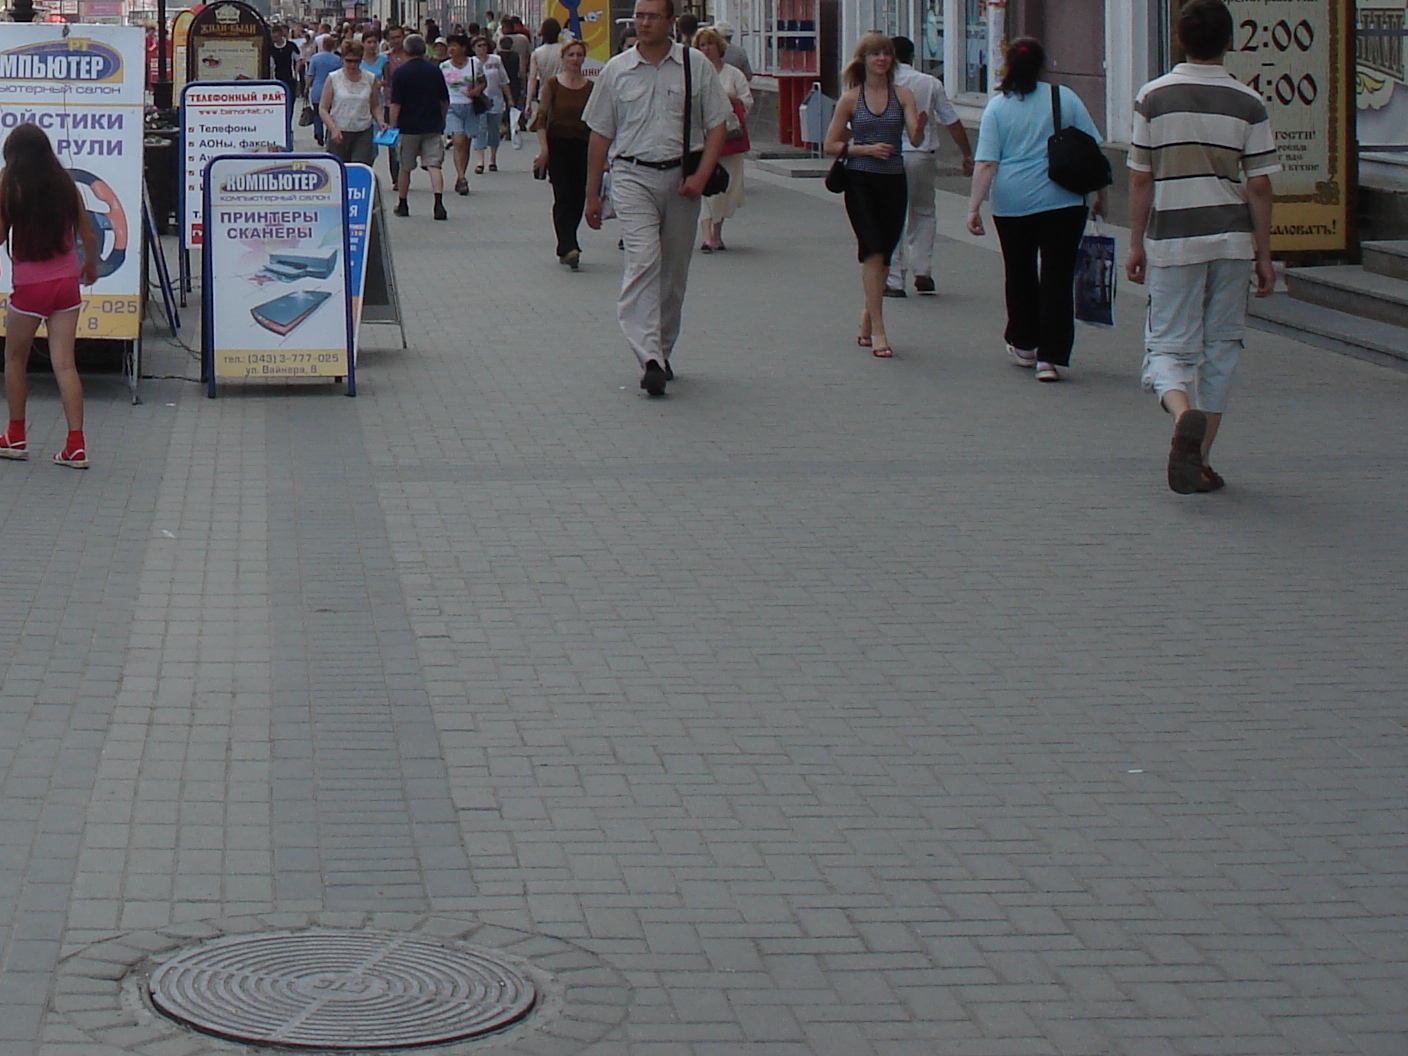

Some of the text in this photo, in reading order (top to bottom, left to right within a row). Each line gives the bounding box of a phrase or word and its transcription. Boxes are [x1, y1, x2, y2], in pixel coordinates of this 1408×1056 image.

[75, 85, 121, 94] салон
[198, 123, 257, 135] Телефоны
[56, 138, 124, 156] РУЛИ
[226, 173, 318, 191] КОМПЬЮТЕР
[220, 211, 319, 224] ПРИНТЕРЫ
[226, 227, 313, 240] СКАНЕРЫ
